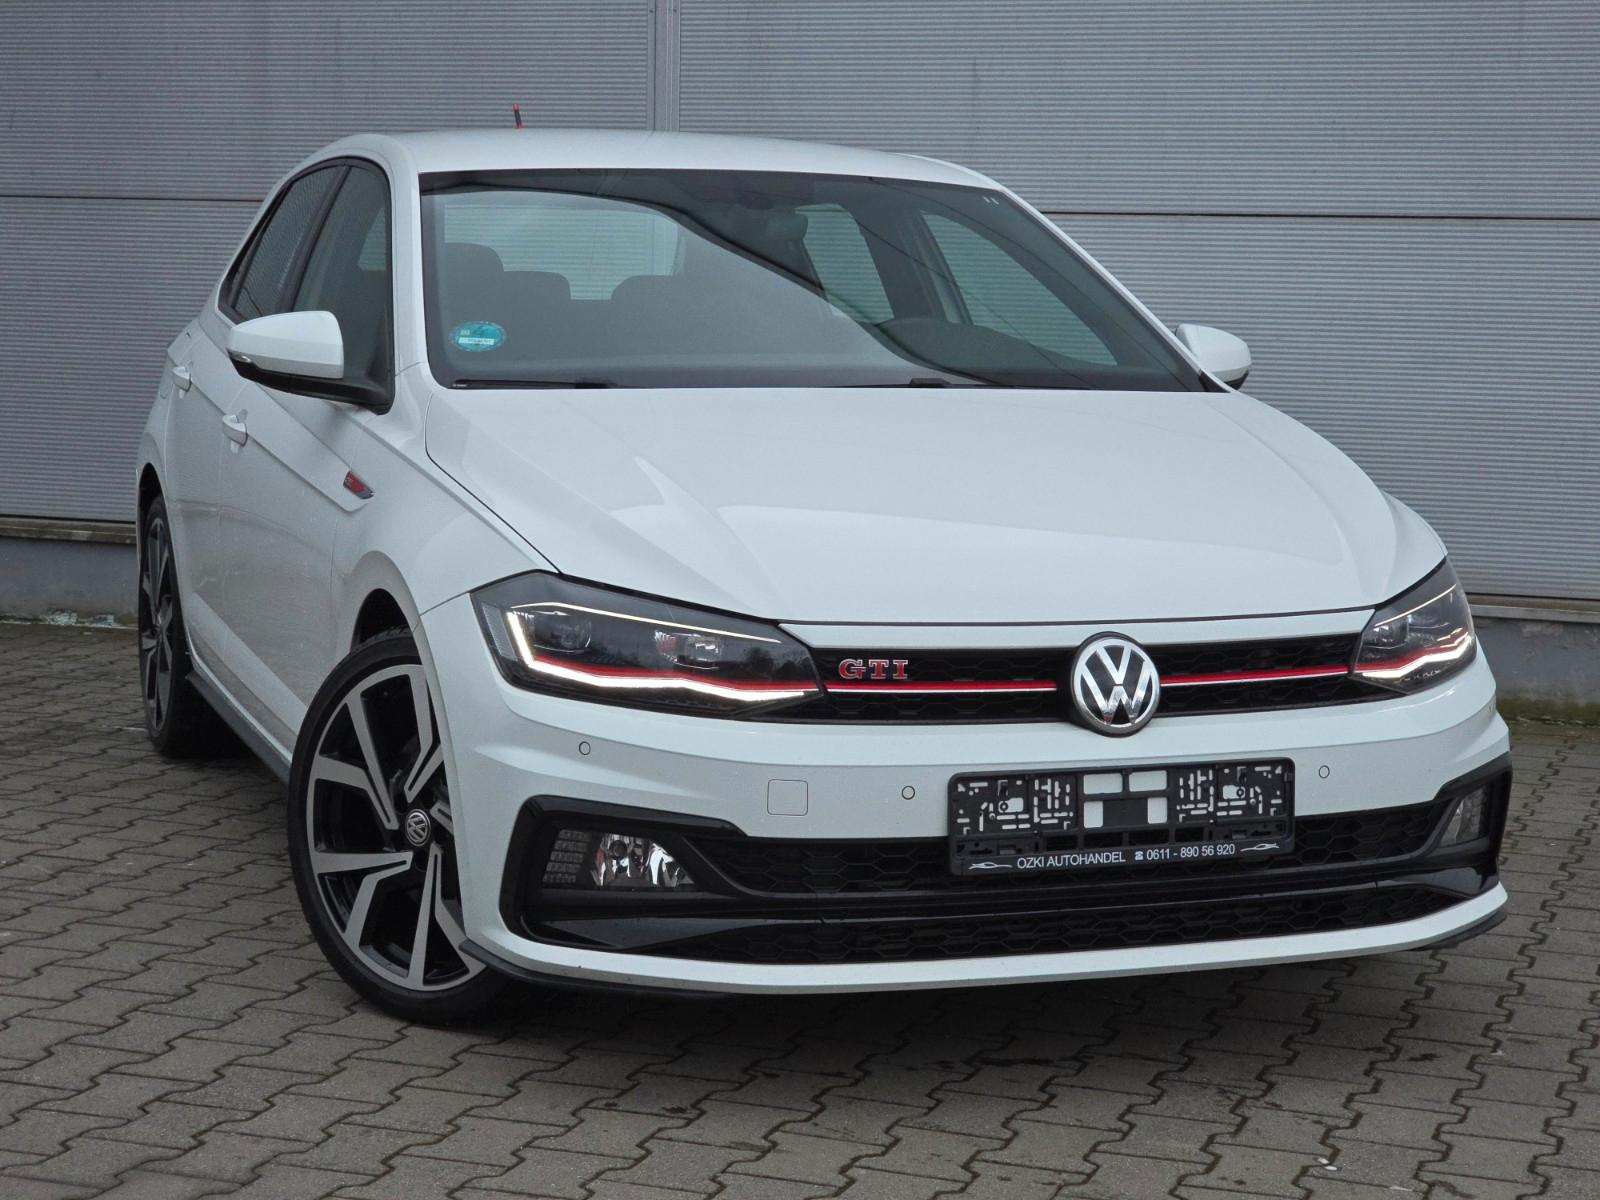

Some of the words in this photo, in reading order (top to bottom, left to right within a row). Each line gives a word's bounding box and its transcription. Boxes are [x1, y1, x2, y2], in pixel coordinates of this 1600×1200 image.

[838, 659, 909, 680] GTI
[1073, 638, 1160, 728] VW
[1016, 856, 1045, 869] OZKI
[1046, 851, 1126, 868] AUTOHANDEL
[1146, 848, 1170, 861] 0611
[1180, 846, 1199, 858] 890
[1201, 845, 1214, 857] 56
[1216, 843, 1236, 856] 920
